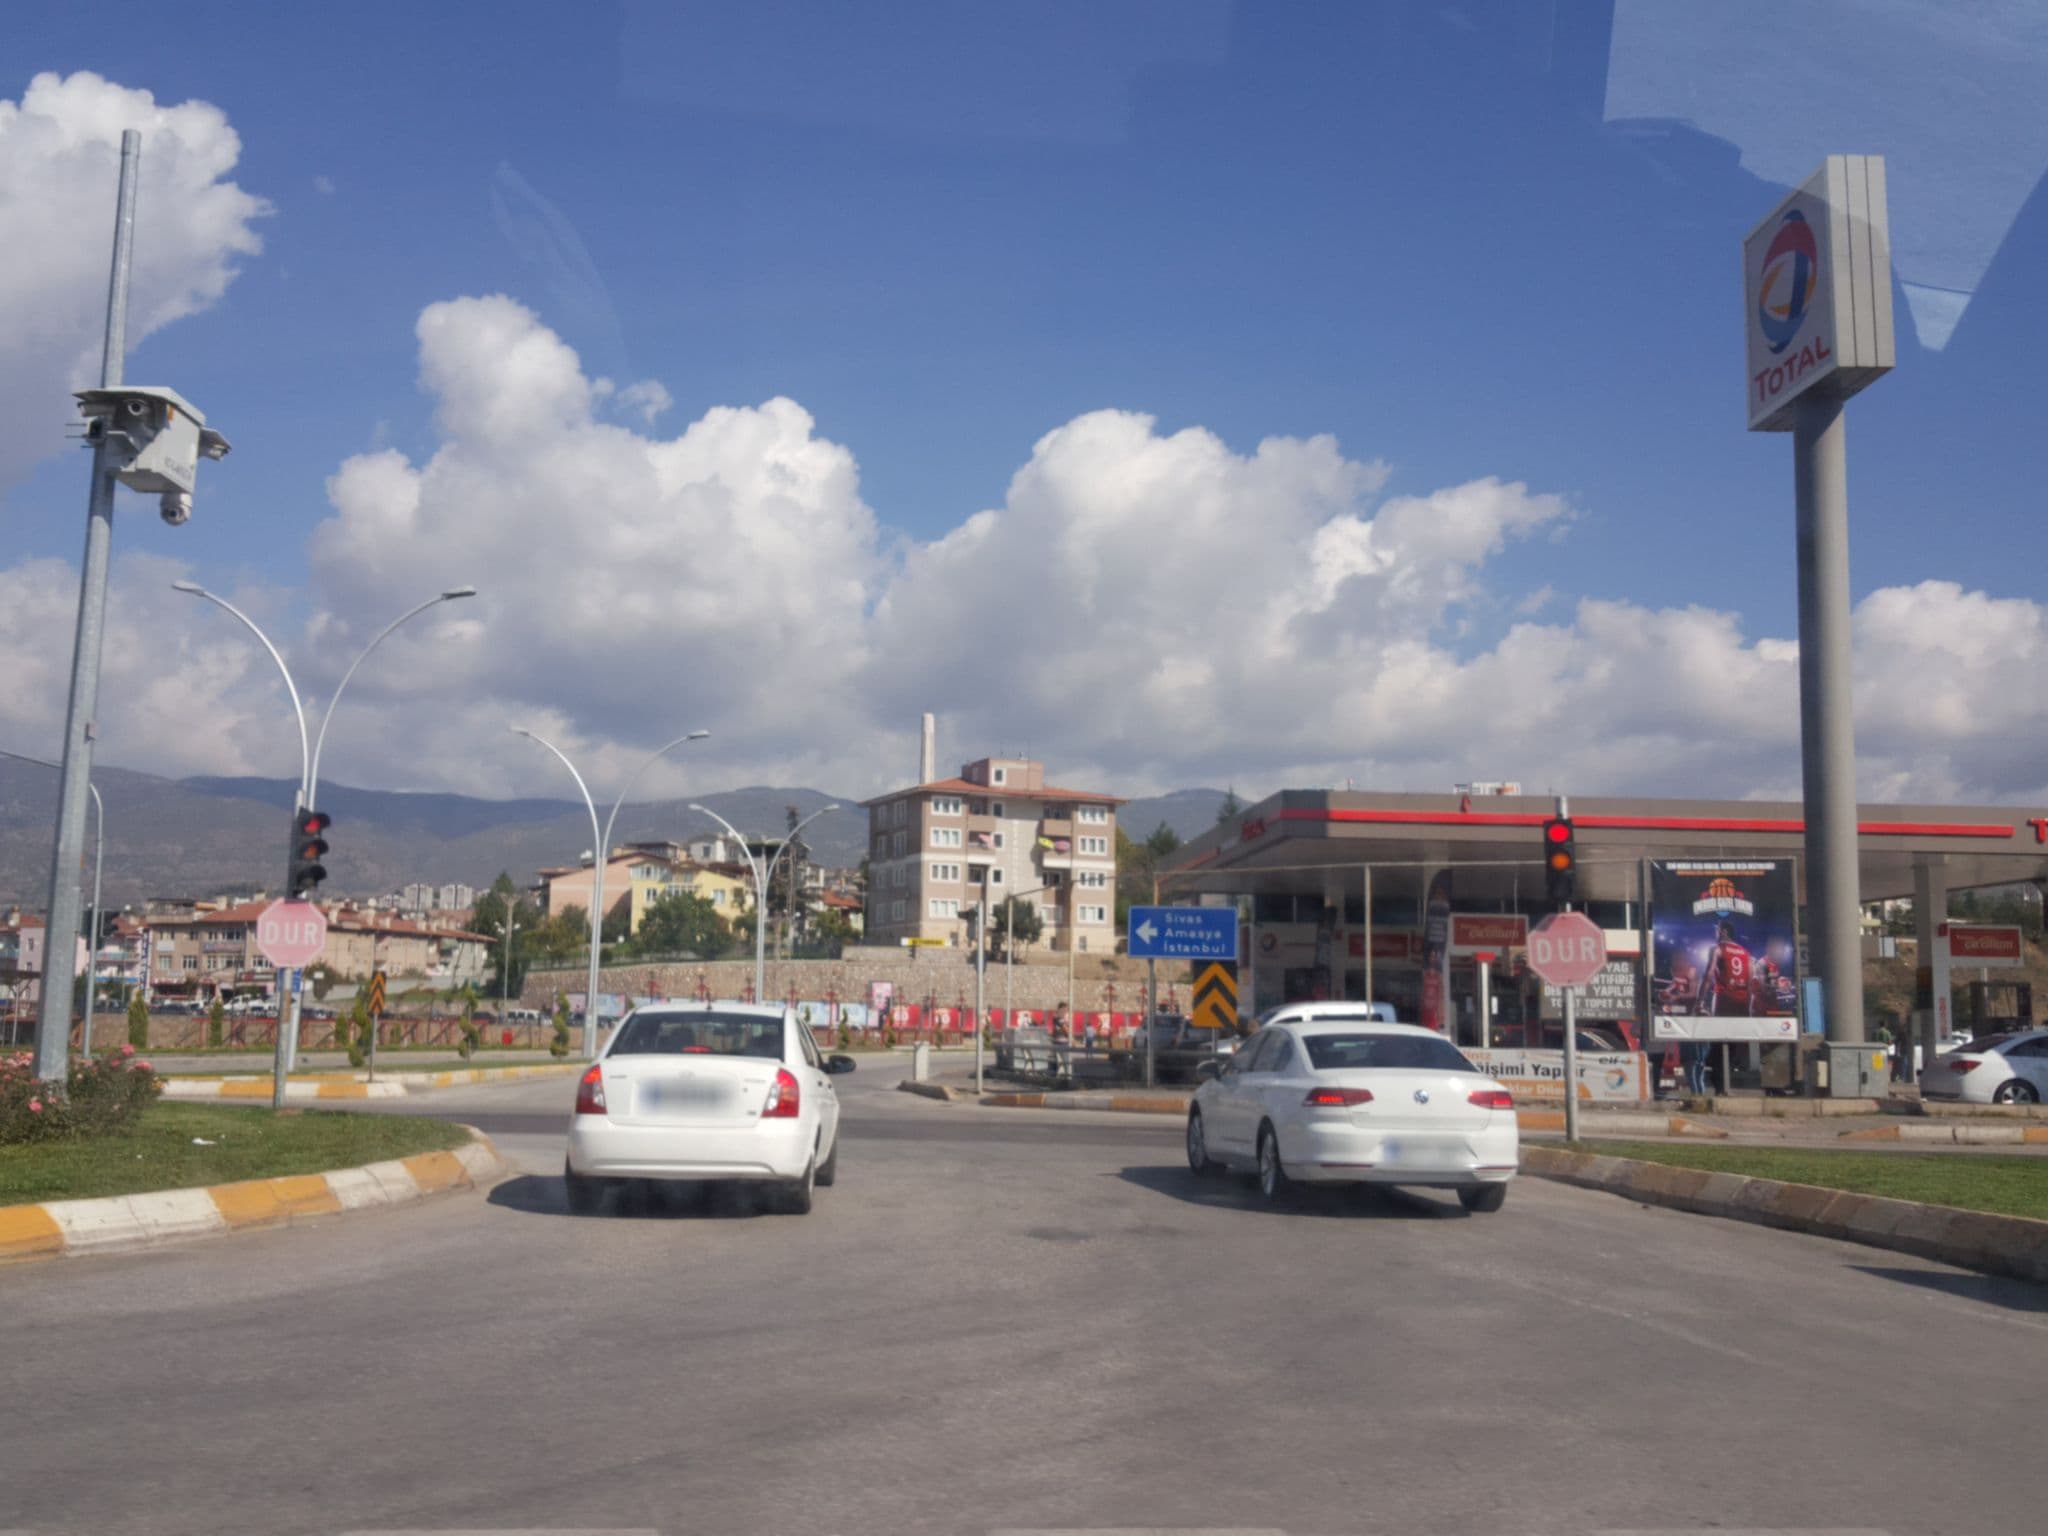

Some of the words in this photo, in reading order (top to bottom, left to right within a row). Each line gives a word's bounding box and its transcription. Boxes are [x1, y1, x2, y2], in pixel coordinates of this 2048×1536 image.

[1754, 335, 1832, 403] TOTAL
[1165, 912, 1203, 923] Sivas
[263, 921, 319, 945] DUR
[1164, 928, 1222, 940] Amasya
[1163, 940, 1226, 953] İstanbul
[1536, 937, 1597, 963] DUR
[1731, 956, 1743, 976] 9
[1477, 1061, 1525, 1079] ğişimi
[1532, 1063, 1586, 1079] Yapr
